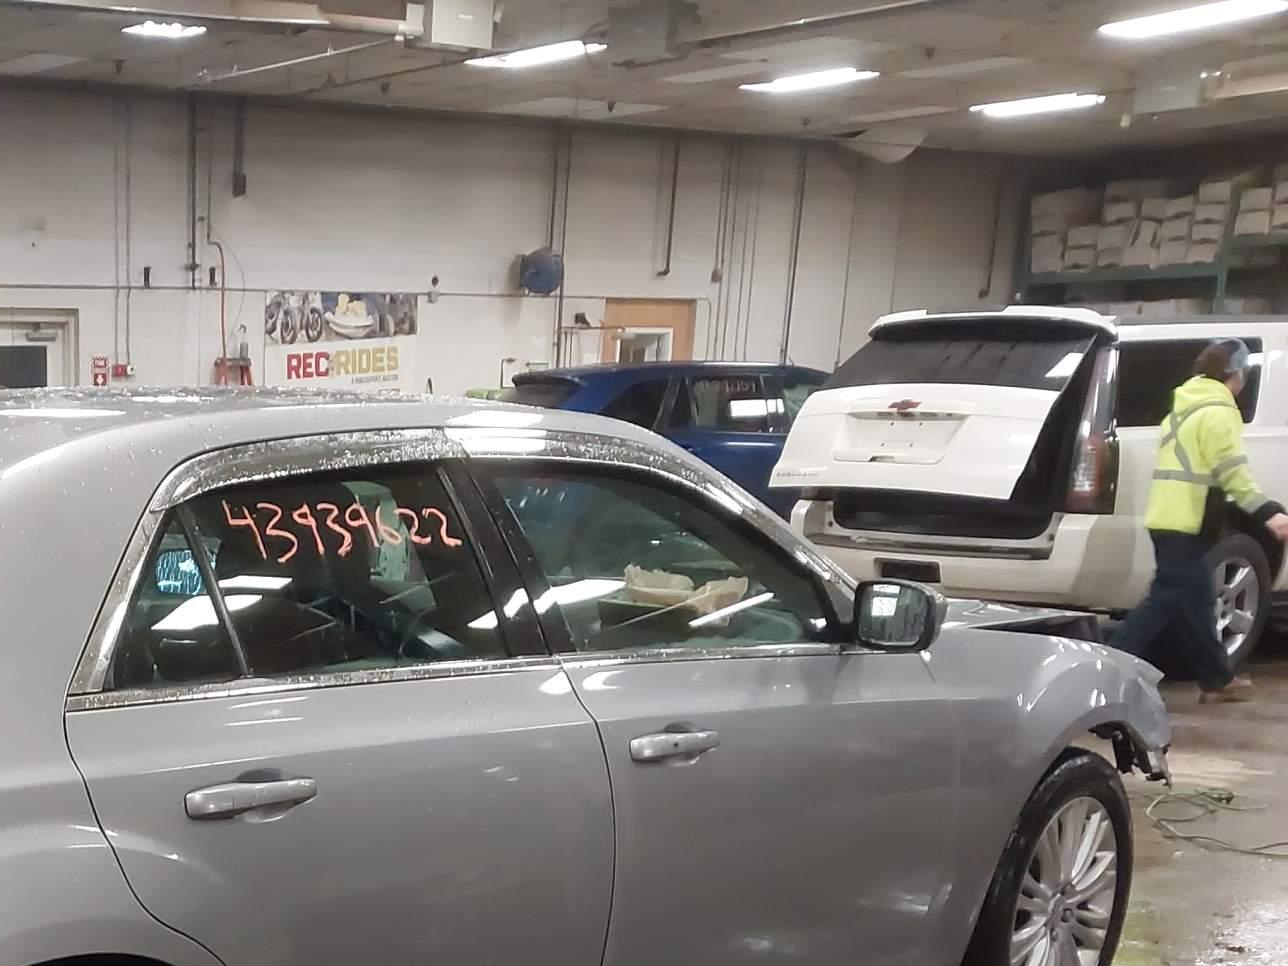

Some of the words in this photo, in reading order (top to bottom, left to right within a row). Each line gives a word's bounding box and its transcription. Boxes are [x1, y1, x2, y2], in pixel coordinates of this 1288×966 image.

[286, 351, 330, 380] REC
[334, 346, 400, 376] RIDES
[222, 500, 463, 563] 43939622
